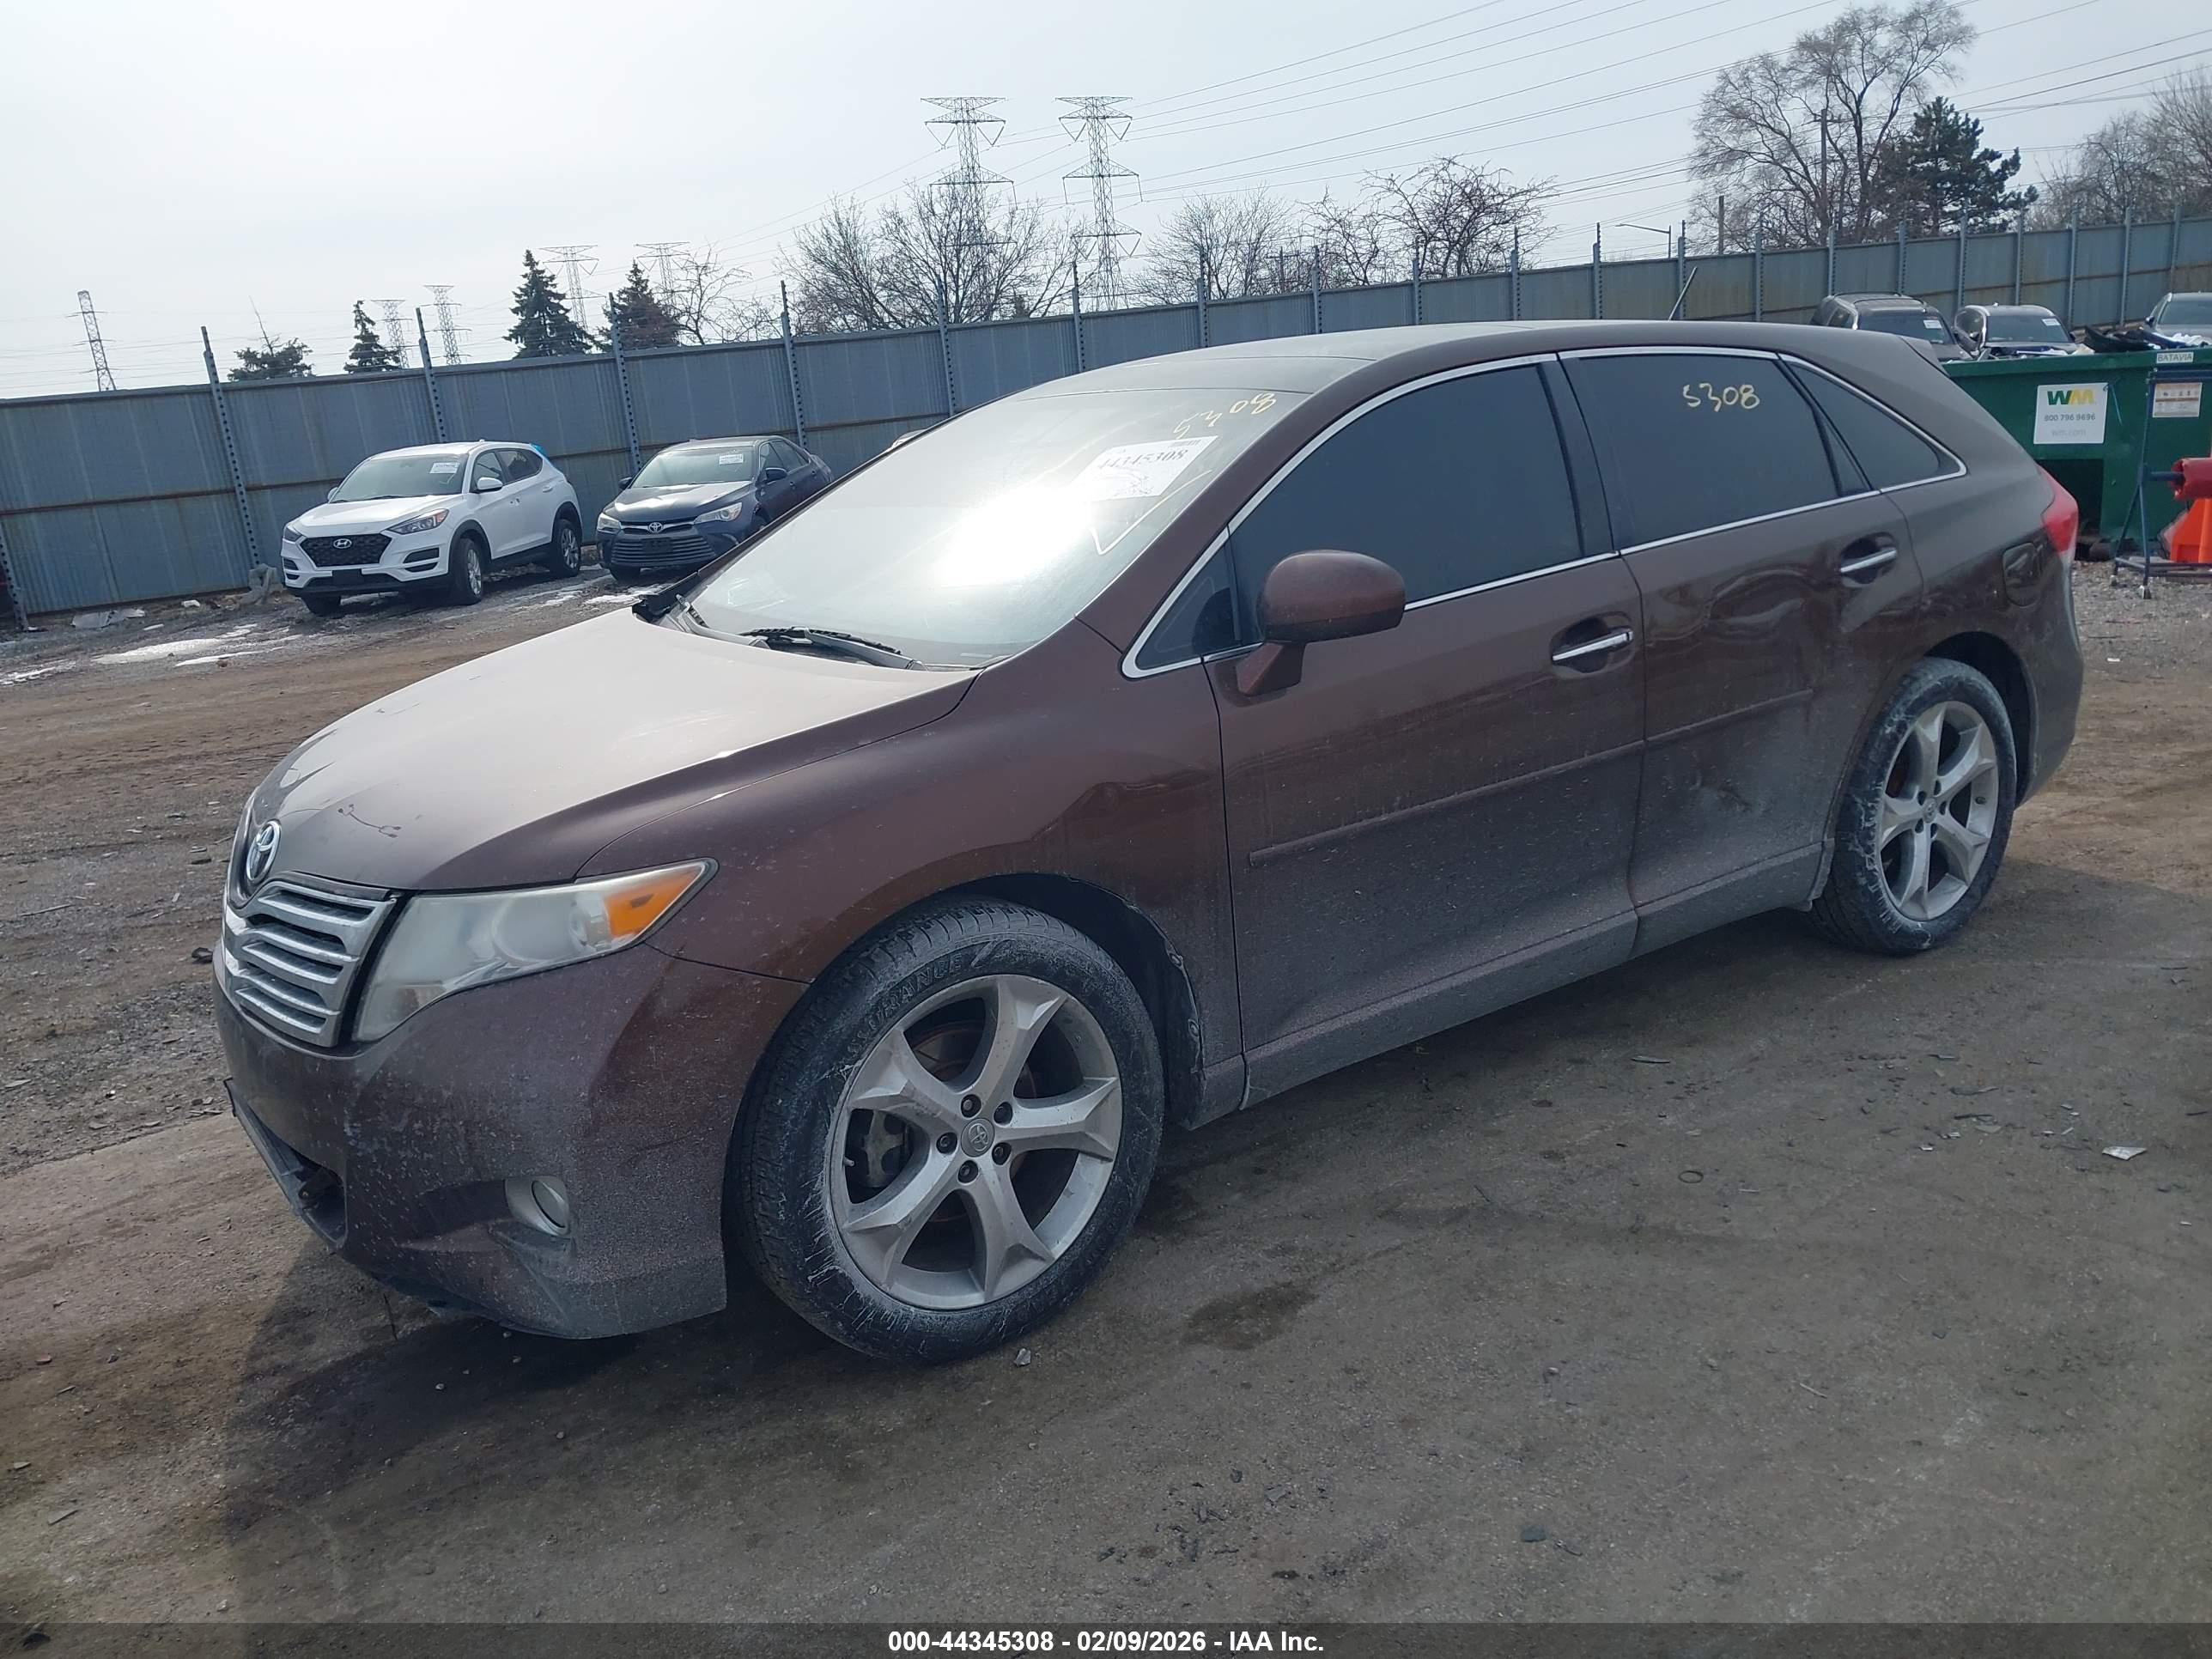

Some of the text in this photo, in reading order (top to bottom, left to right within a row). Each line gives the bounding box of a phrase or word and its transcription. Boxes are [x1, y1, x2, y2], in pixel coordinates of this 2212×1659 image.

[2157, 352, 2192, 362] BATAVIA
[1683, 382, 1760, 412] 5308
[2047, 389, 2095, 406] WM
